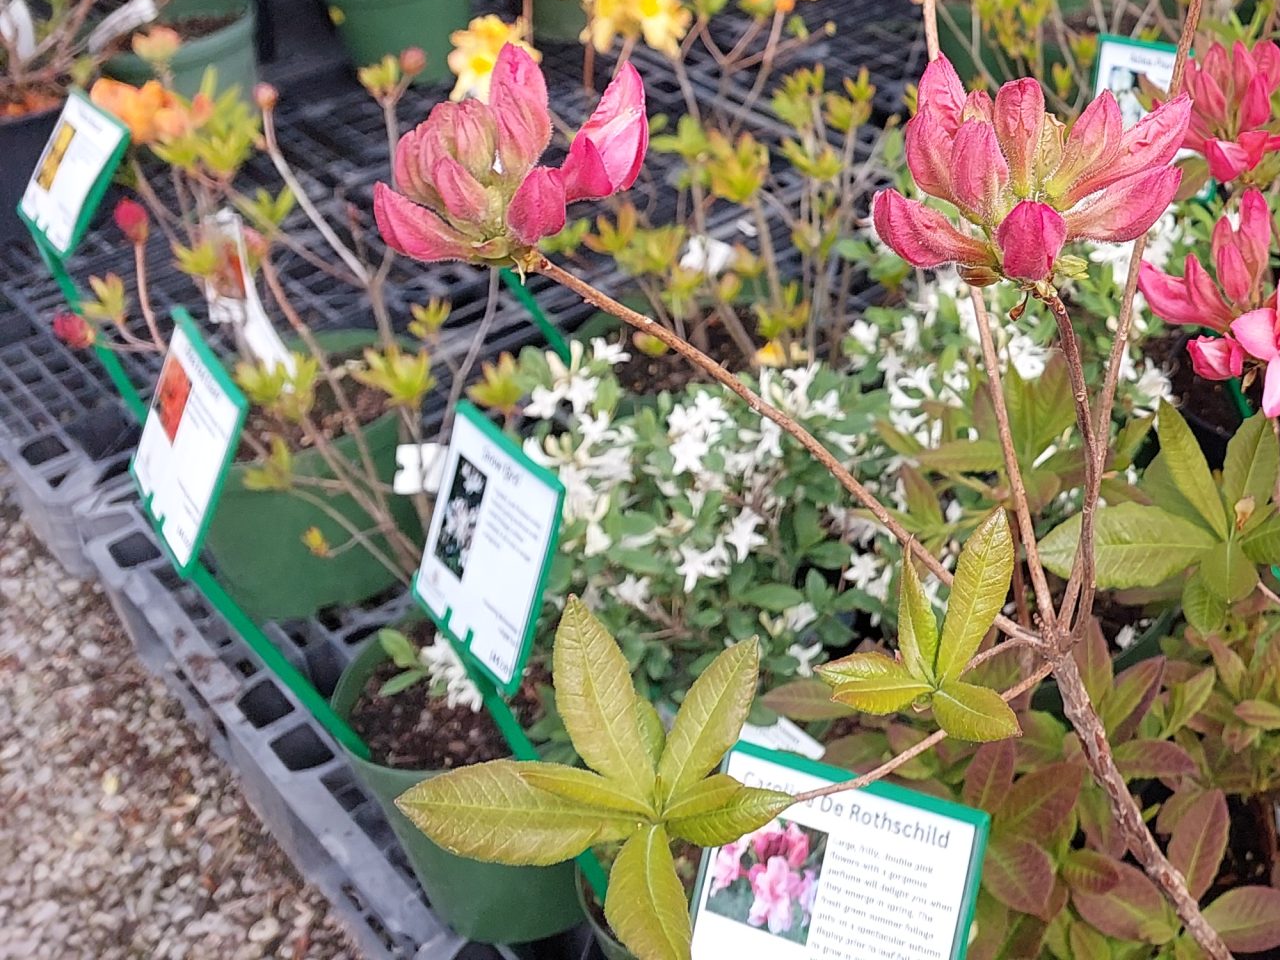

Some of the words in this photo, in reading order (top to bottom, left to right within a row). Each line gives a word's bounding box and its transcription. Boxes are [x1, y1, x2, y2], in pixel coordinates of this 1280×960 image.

[743, 771, 814, 809] Carolia
[820, 792, 843, 817] De
[849, 802, 950, 849] Rothschild
